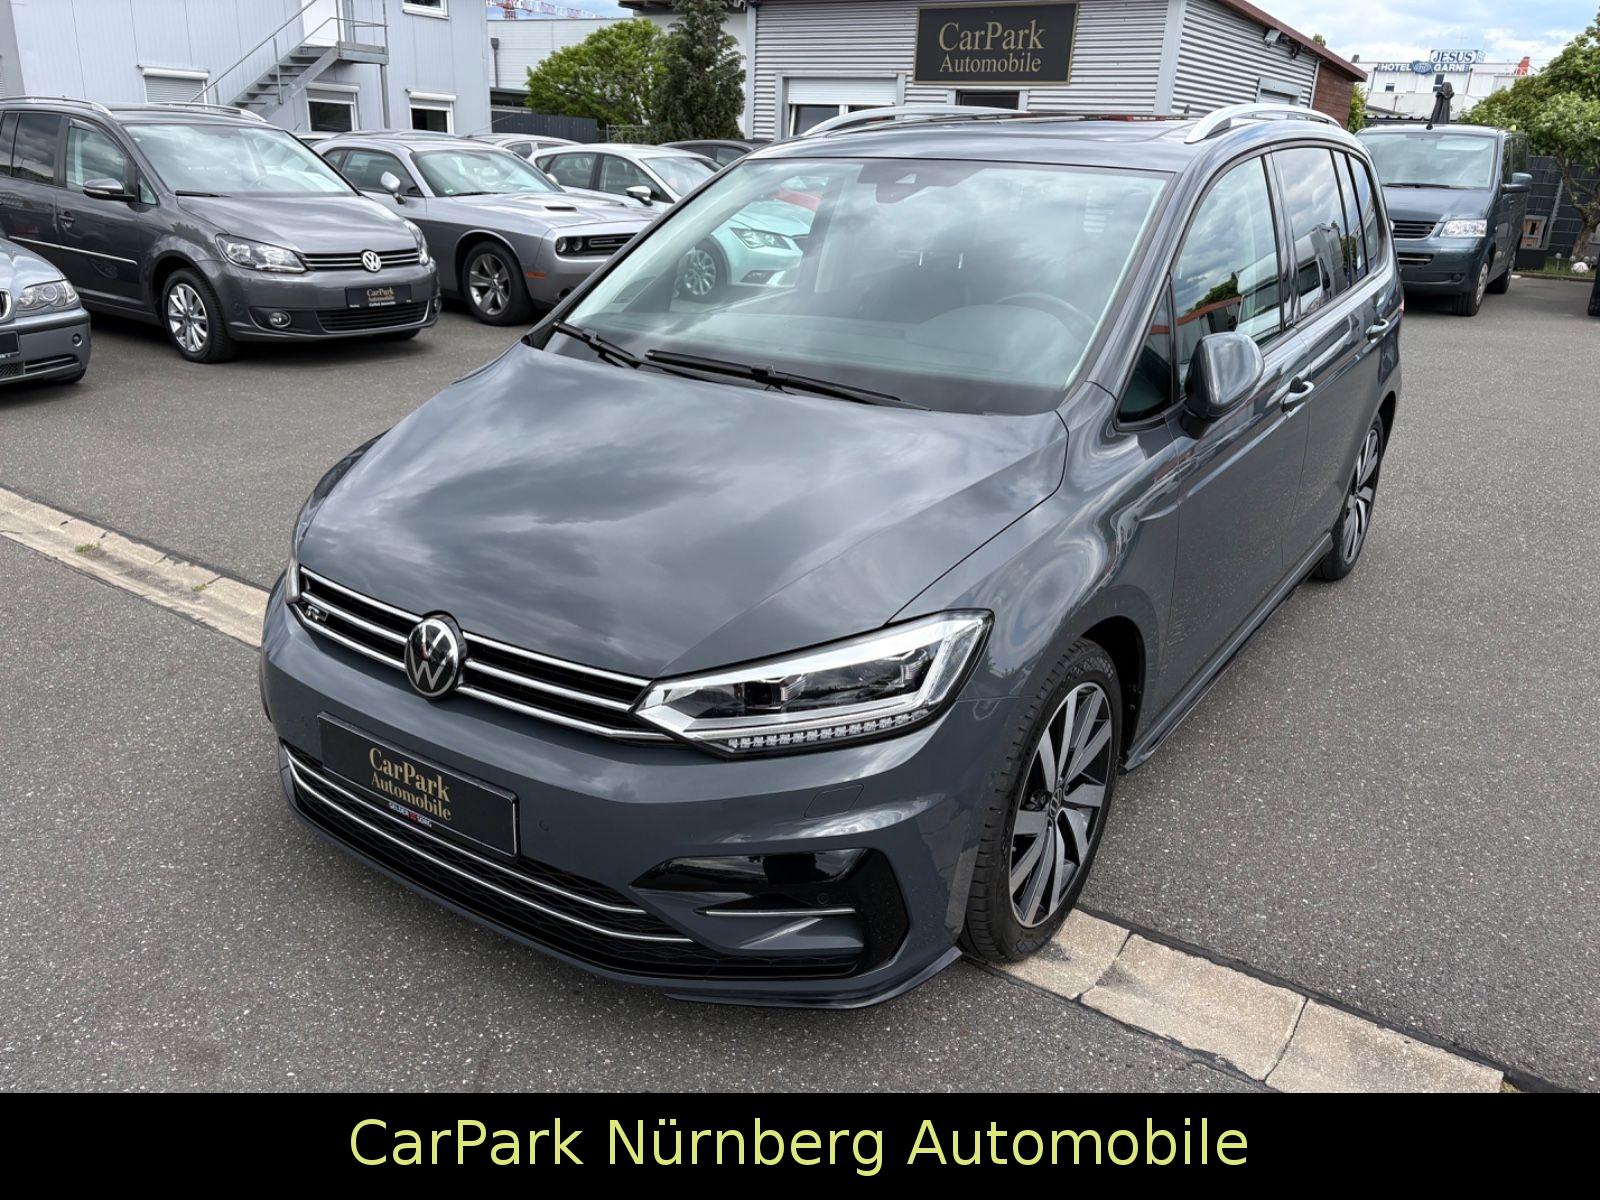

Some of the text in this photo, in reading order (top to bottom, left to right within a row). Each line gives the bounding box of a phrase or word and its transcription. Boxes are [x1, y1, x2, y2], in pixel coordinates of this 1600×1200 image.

[939, 20, 1045, 50] CarPark
[940, 53, 1041, 72] Automobile
[1382, 63, 1412, 72] HOTEL
[1434, 63, 1466, 72] GARNI
[1433, 52, 1472, 64] JESUS
[369, 747, 450, 801] CarPark
[371, 772, 452, 821] Automobile
